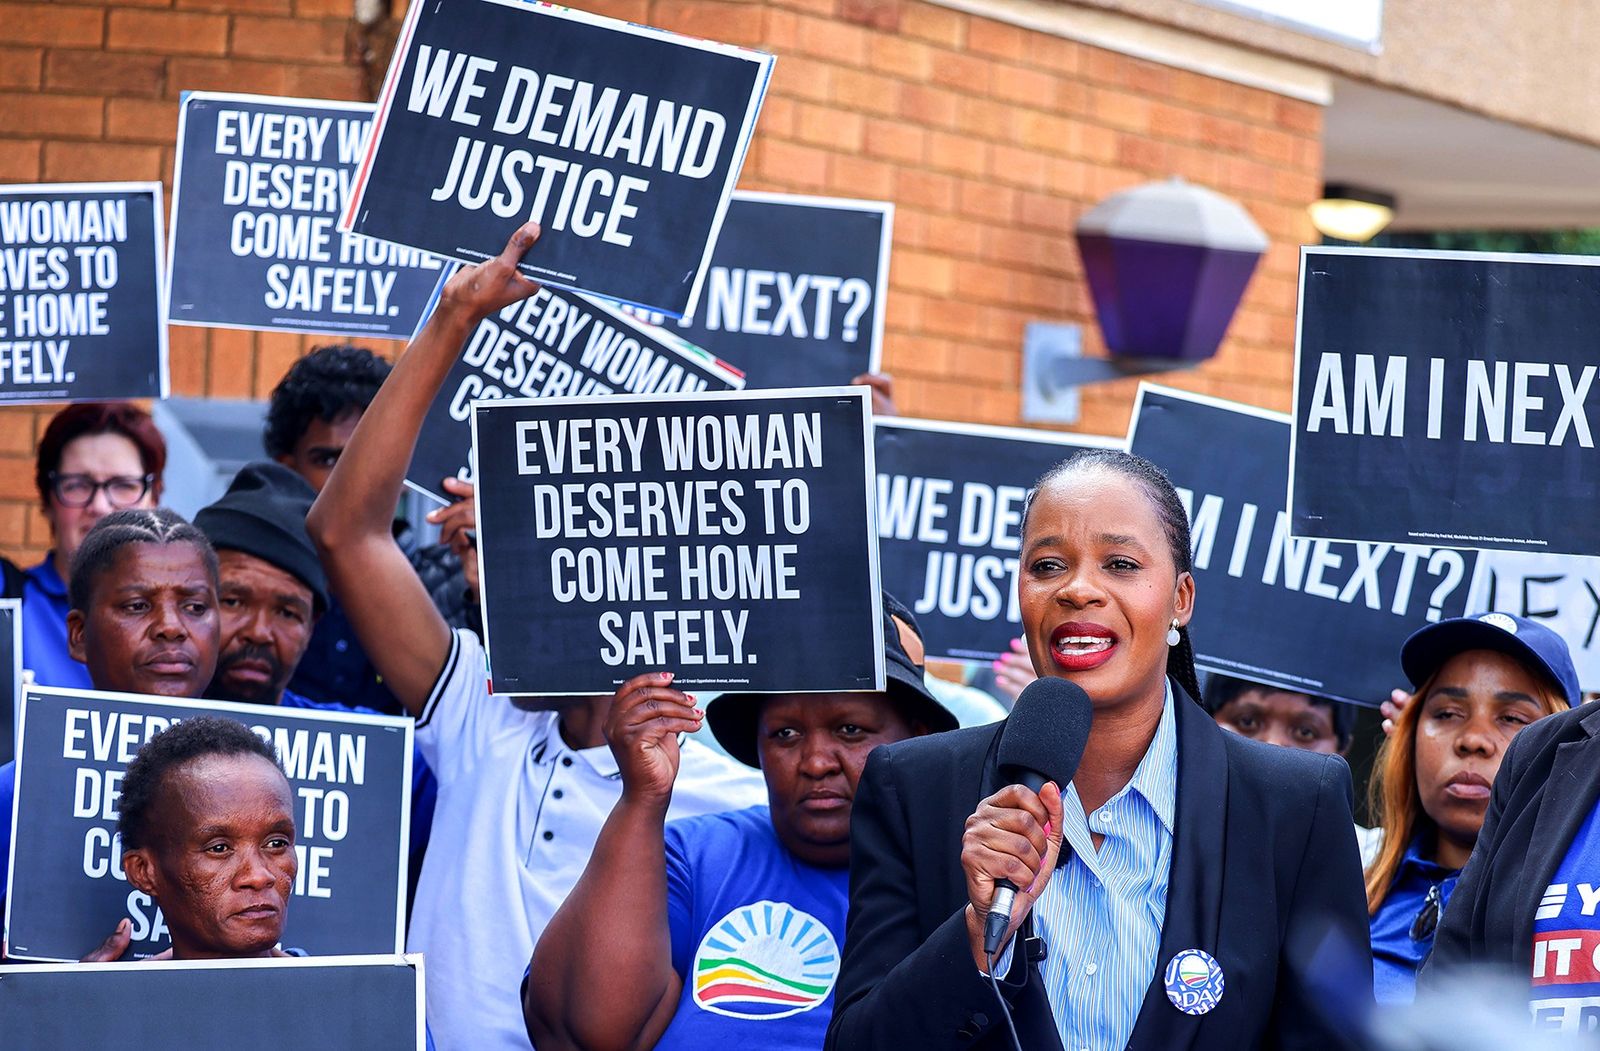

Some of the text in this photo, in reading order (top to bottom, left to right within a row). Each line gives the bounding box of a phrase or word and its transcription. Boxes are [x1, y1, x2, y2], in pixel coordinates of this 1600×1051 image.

[215, 109, 333, 162] EVERY
[407, 44, 727, 179] WE DEMAND
[0, 199, 128, 244] WOMAN
[430, 136, 650, 248] JUSTICE
[74, 245, 119, 289] TO
[230, 211, 334, 263] COME
[13, 292, 110, 338] HOME
[264, 263, 400, 317] SAFELY.
[705, 266, 873, 342] NEXT?
[1306, 351, 1600, 449] AM I NEX
[515, 417, 648, 475] EVERY
[656, 412, 823, 472] WOMAN
[533, 478, 810, 539] DESERVES TO
[876, 473, 954, 544] WE
[550, 544, 801, 603] COME HOME
[914, 550, 1022, 623] JUST
[1227, 502, 1258, 578] I
[1261, 510, 1465, 624] NEXT?
[598, 609, 758, 667] SAFELY.
[63, 708, 367, 785] EVE MAN
[298, 787, 350, 841] TO
